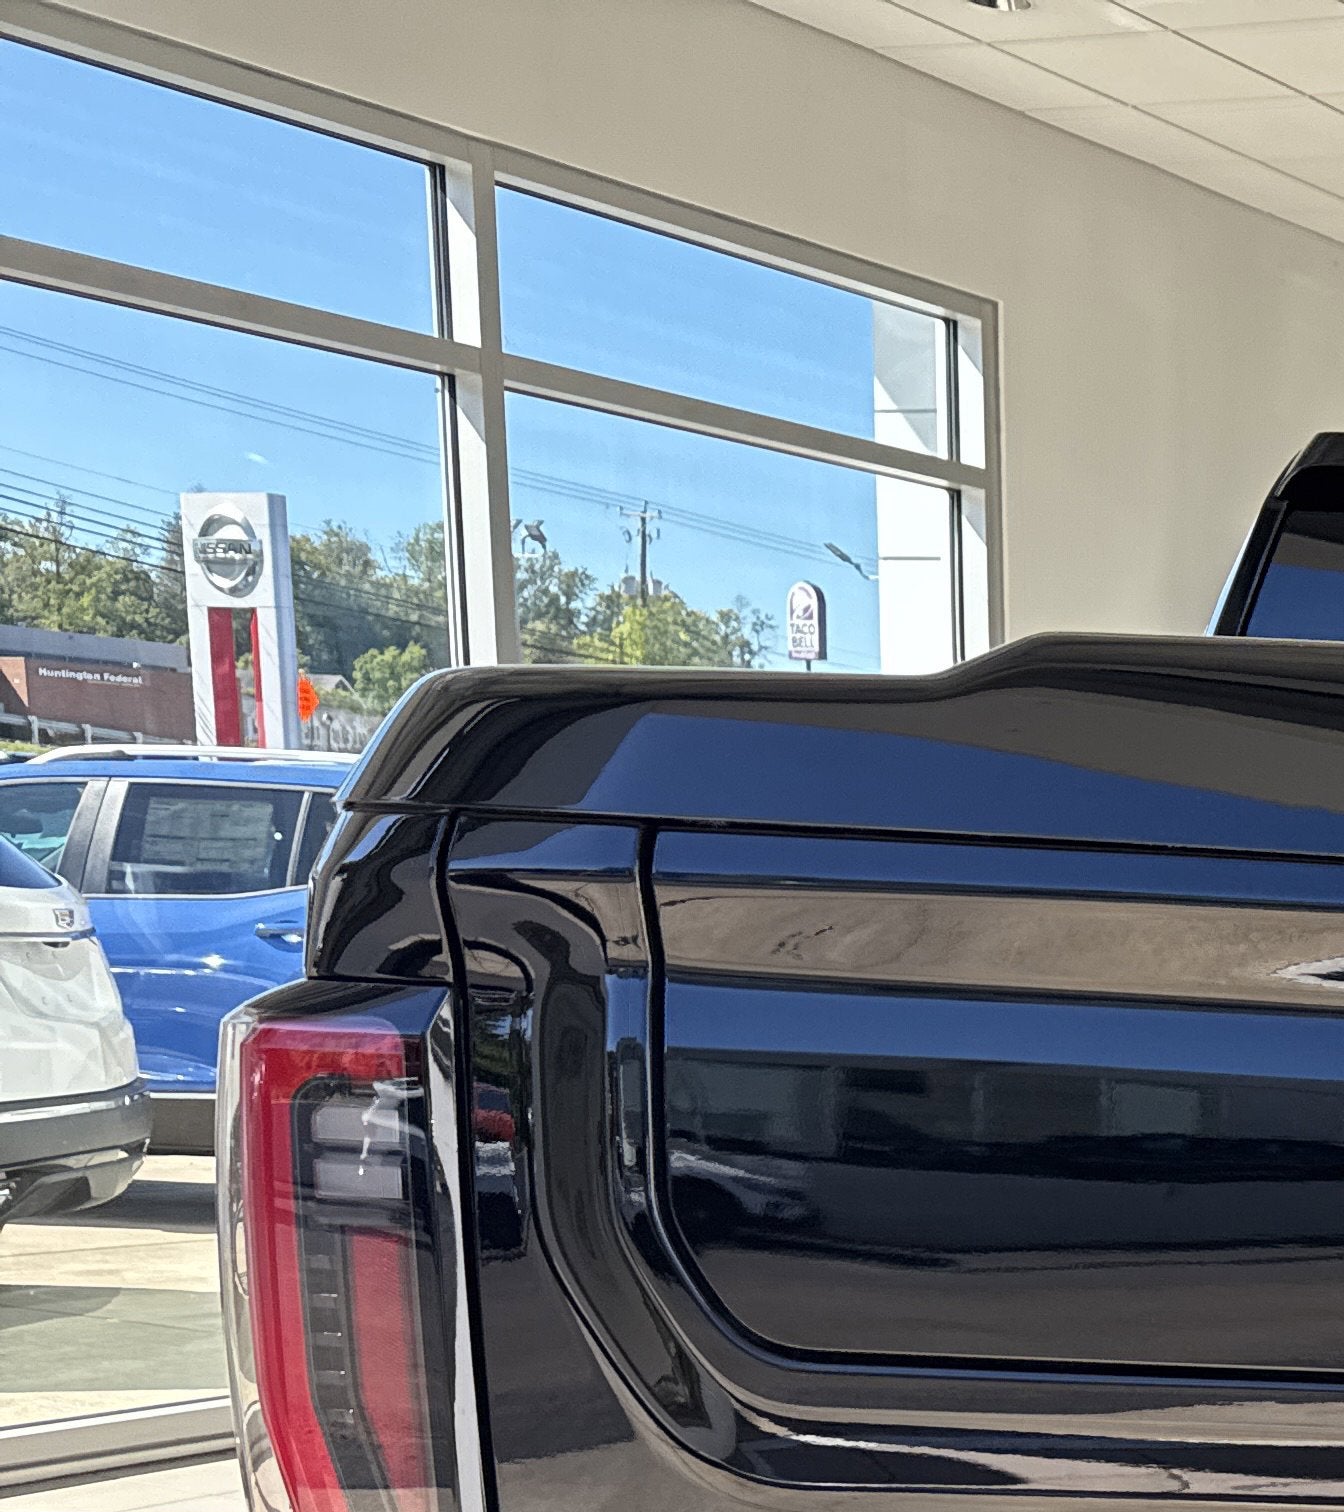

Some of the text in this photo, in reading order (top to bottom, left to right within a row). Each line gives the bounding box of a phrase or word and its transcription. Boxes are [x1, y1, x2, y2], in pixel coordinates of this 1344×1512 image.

[194, 541, 252, 557] NISSAN
[790, 623, 815, 635] TACO
[791, 636, 815, 648] BELL
[38, 667, 101, 681] Huntington
[102, 672, 142, 684] Federal
